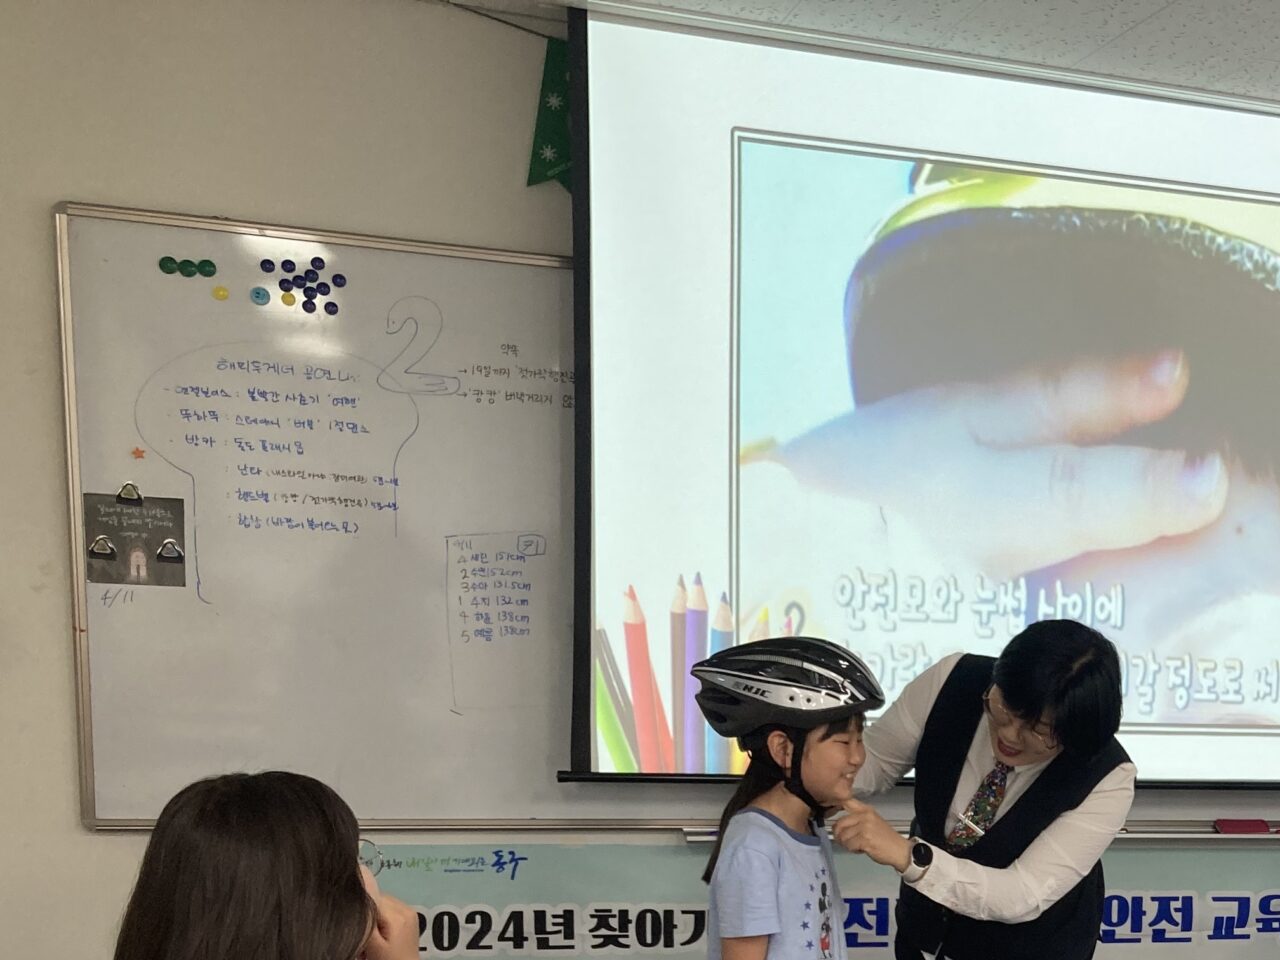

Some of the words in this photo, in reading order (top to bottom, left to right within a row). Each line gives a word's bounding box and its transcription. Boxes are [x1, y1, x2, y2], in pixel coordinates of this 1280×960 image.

[835, 567, 963, 632] 안전모와
[1037, 579, 1125, 630] 사이에
[1166, 652, 1245, 711] 정도로
[491, 850, 528, 881] 동구
[1101, 894, 1194, 943] 안전
